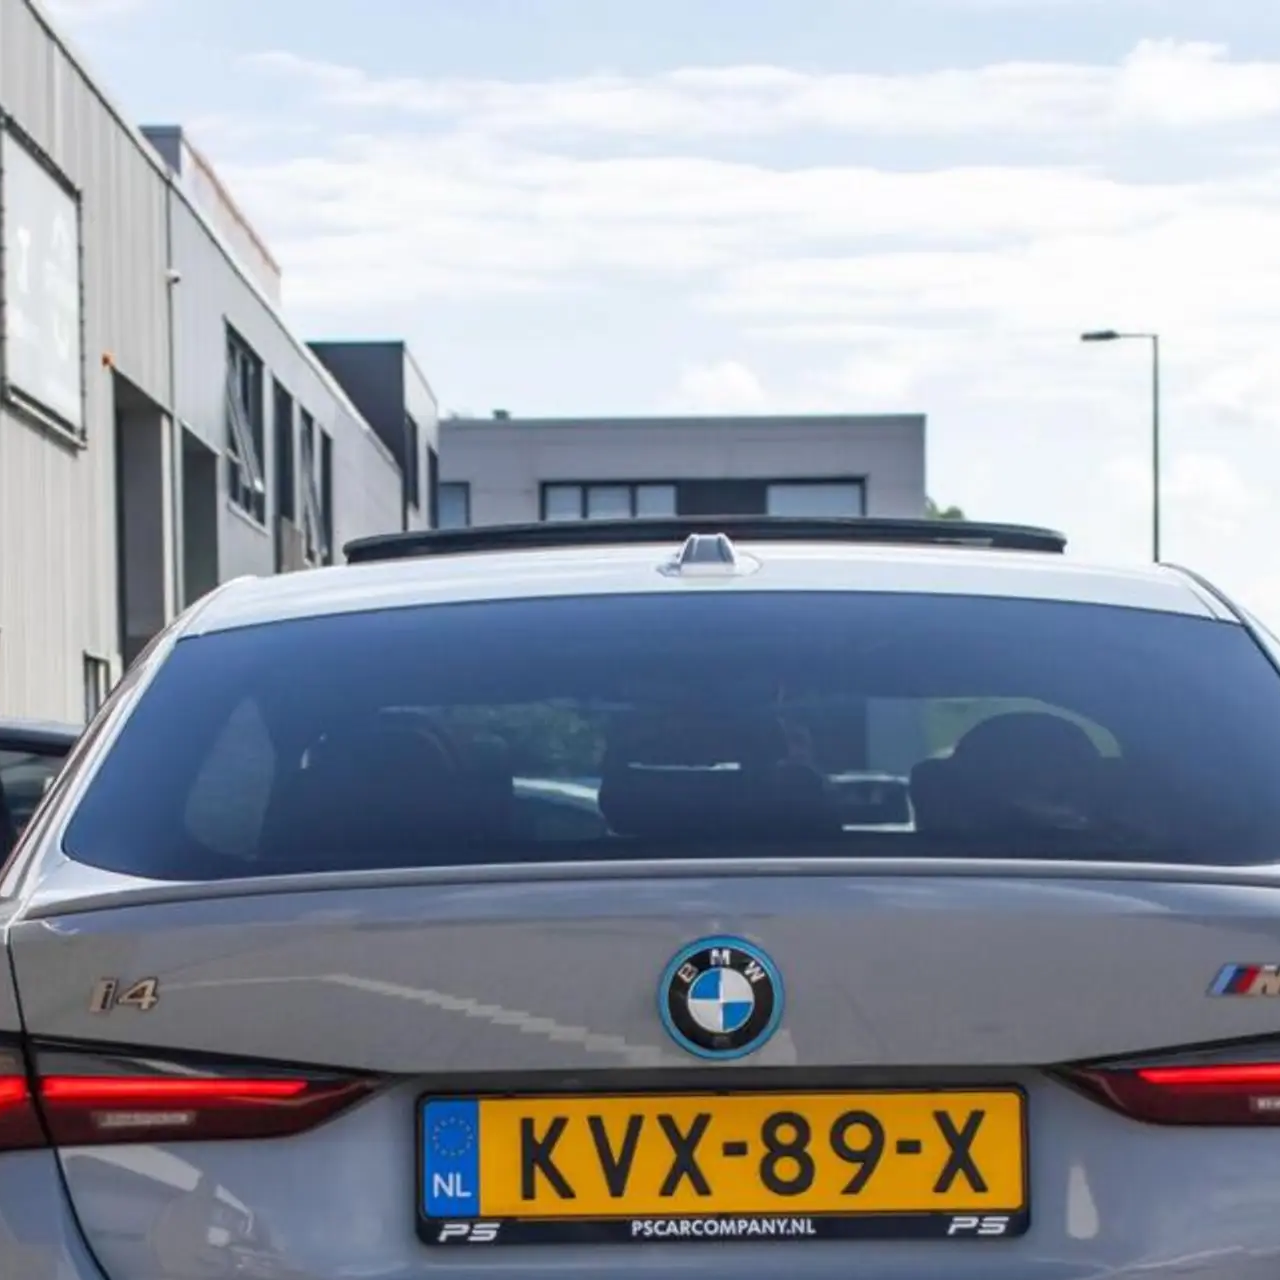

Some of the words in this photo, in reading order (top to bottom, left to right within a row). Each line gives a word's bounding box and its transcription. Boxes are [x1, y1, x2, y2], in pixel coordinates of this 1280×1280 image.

[677, 948, 766, 984] BMW
[89, 978, 158, 1013] i4
[519, 1109, 989, 1201] KVX-89-X
[432, 1172, 472, 1198] NL
[437, 1223, 501, 1243] PS
[631, 1218, 817, 1237] PSCARCOMPANY.NL
[947, 1216, 1010, 1235] PS
